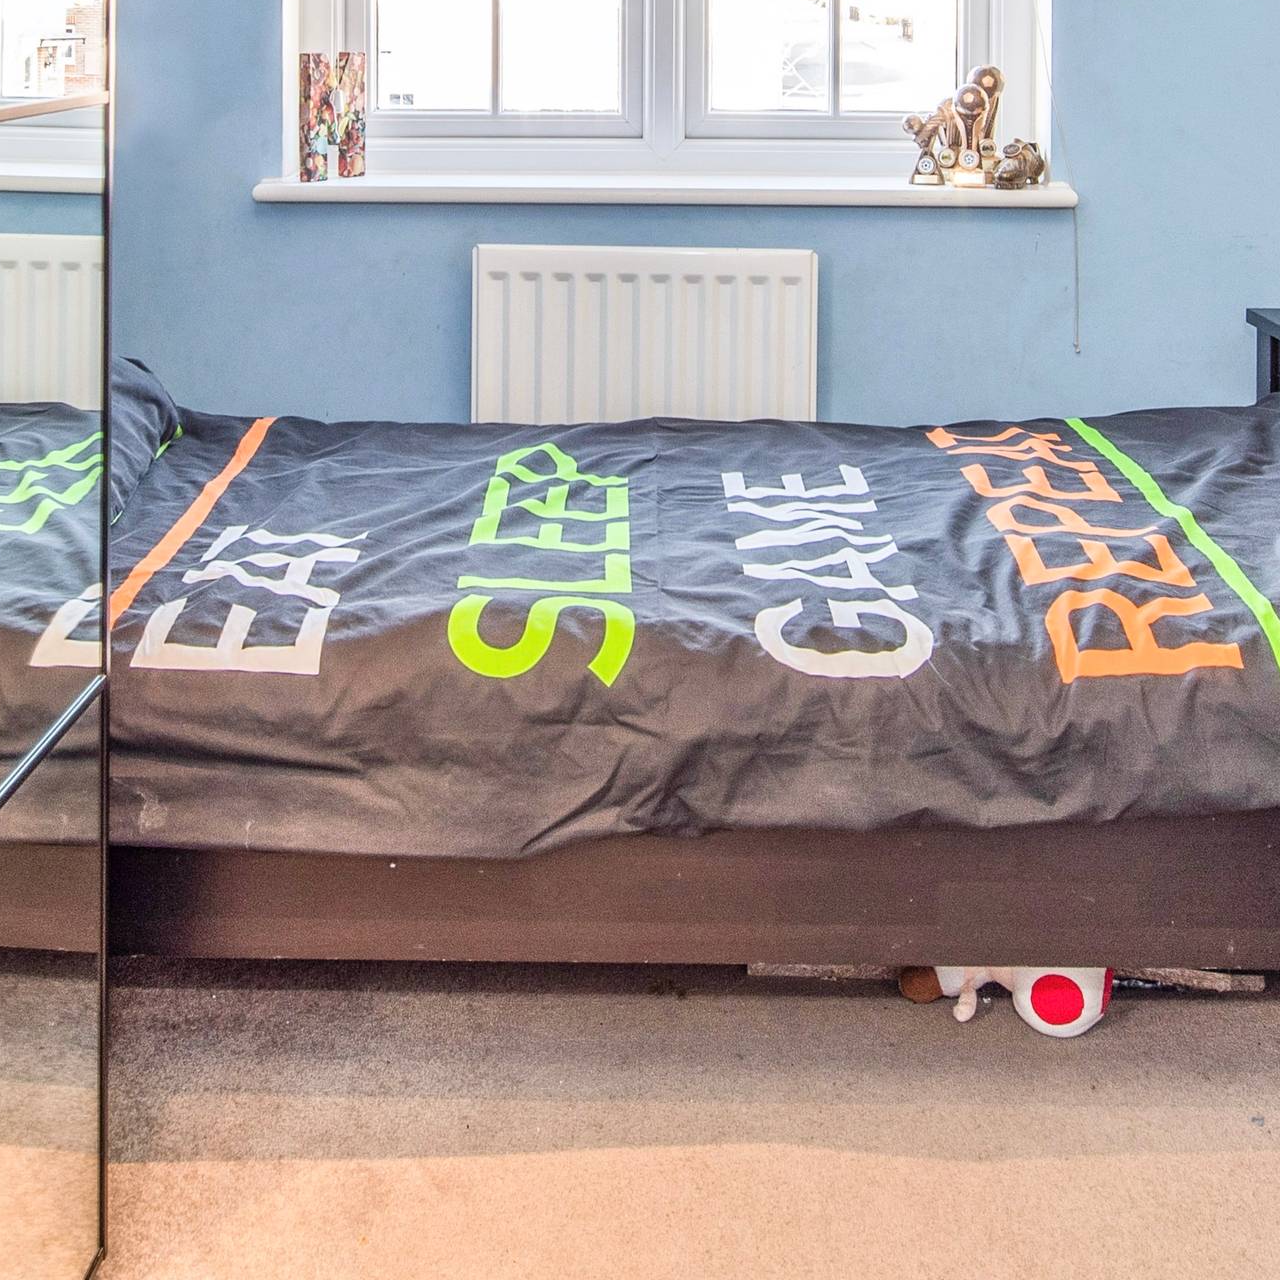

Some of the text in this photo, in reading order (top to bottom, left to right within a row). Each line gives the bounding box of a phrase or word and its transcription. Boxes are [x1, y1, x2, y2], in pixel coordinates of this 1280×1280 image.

[129, 524, 369, 677] EAT
[446, 441, 637, 688] SLEEP
[721, 463, 935, 680] GAME
[924, 426, 1245, 685] REPEAT
